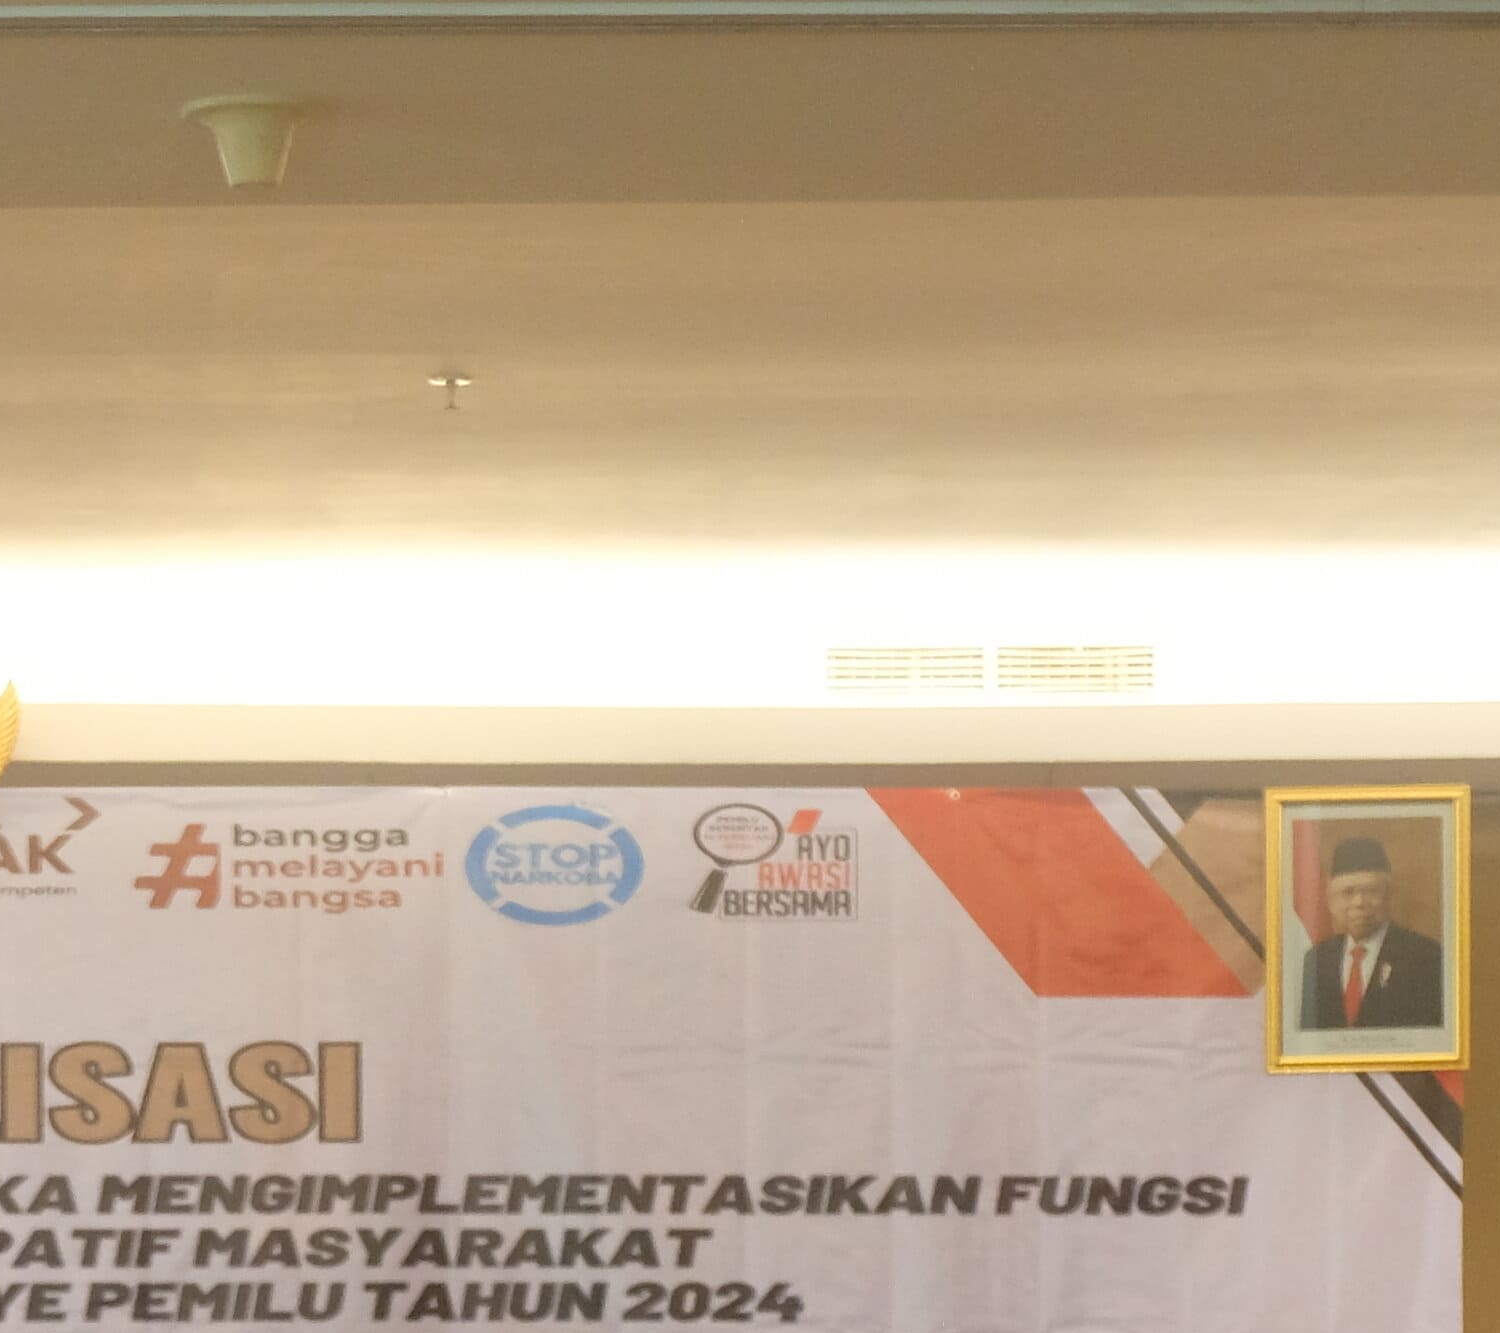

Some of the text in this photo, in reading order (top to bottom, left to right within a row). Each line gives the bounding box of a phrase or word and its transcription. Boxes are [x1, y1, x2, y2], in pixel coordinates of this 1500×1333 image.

[233, 824, 409, 852] bangga
[797, 834, 851, 861] AYO
[233, 852, 445, 882] melayani
[495, 843, 615, 869] STOP
[488, 870, 620, 886] NARKOBA
[757, 863, 851, 889] AWASI
[233, 885, 402, 914] bangsa
[723, 890, 852, 917] BERSAMA
[95, 1173, 982, 1216] MENGIMPLEMENTASIKAN
[994, 1174, 1250, 1217] FUNGSI
[192, 1227, 714, 1269] MASYARAKAT
[84, 1281, 347, 1323] PEMILU
[363, 1281, 609, 1323] TAHUN
[621, 1281, 806, 1324] 2024
